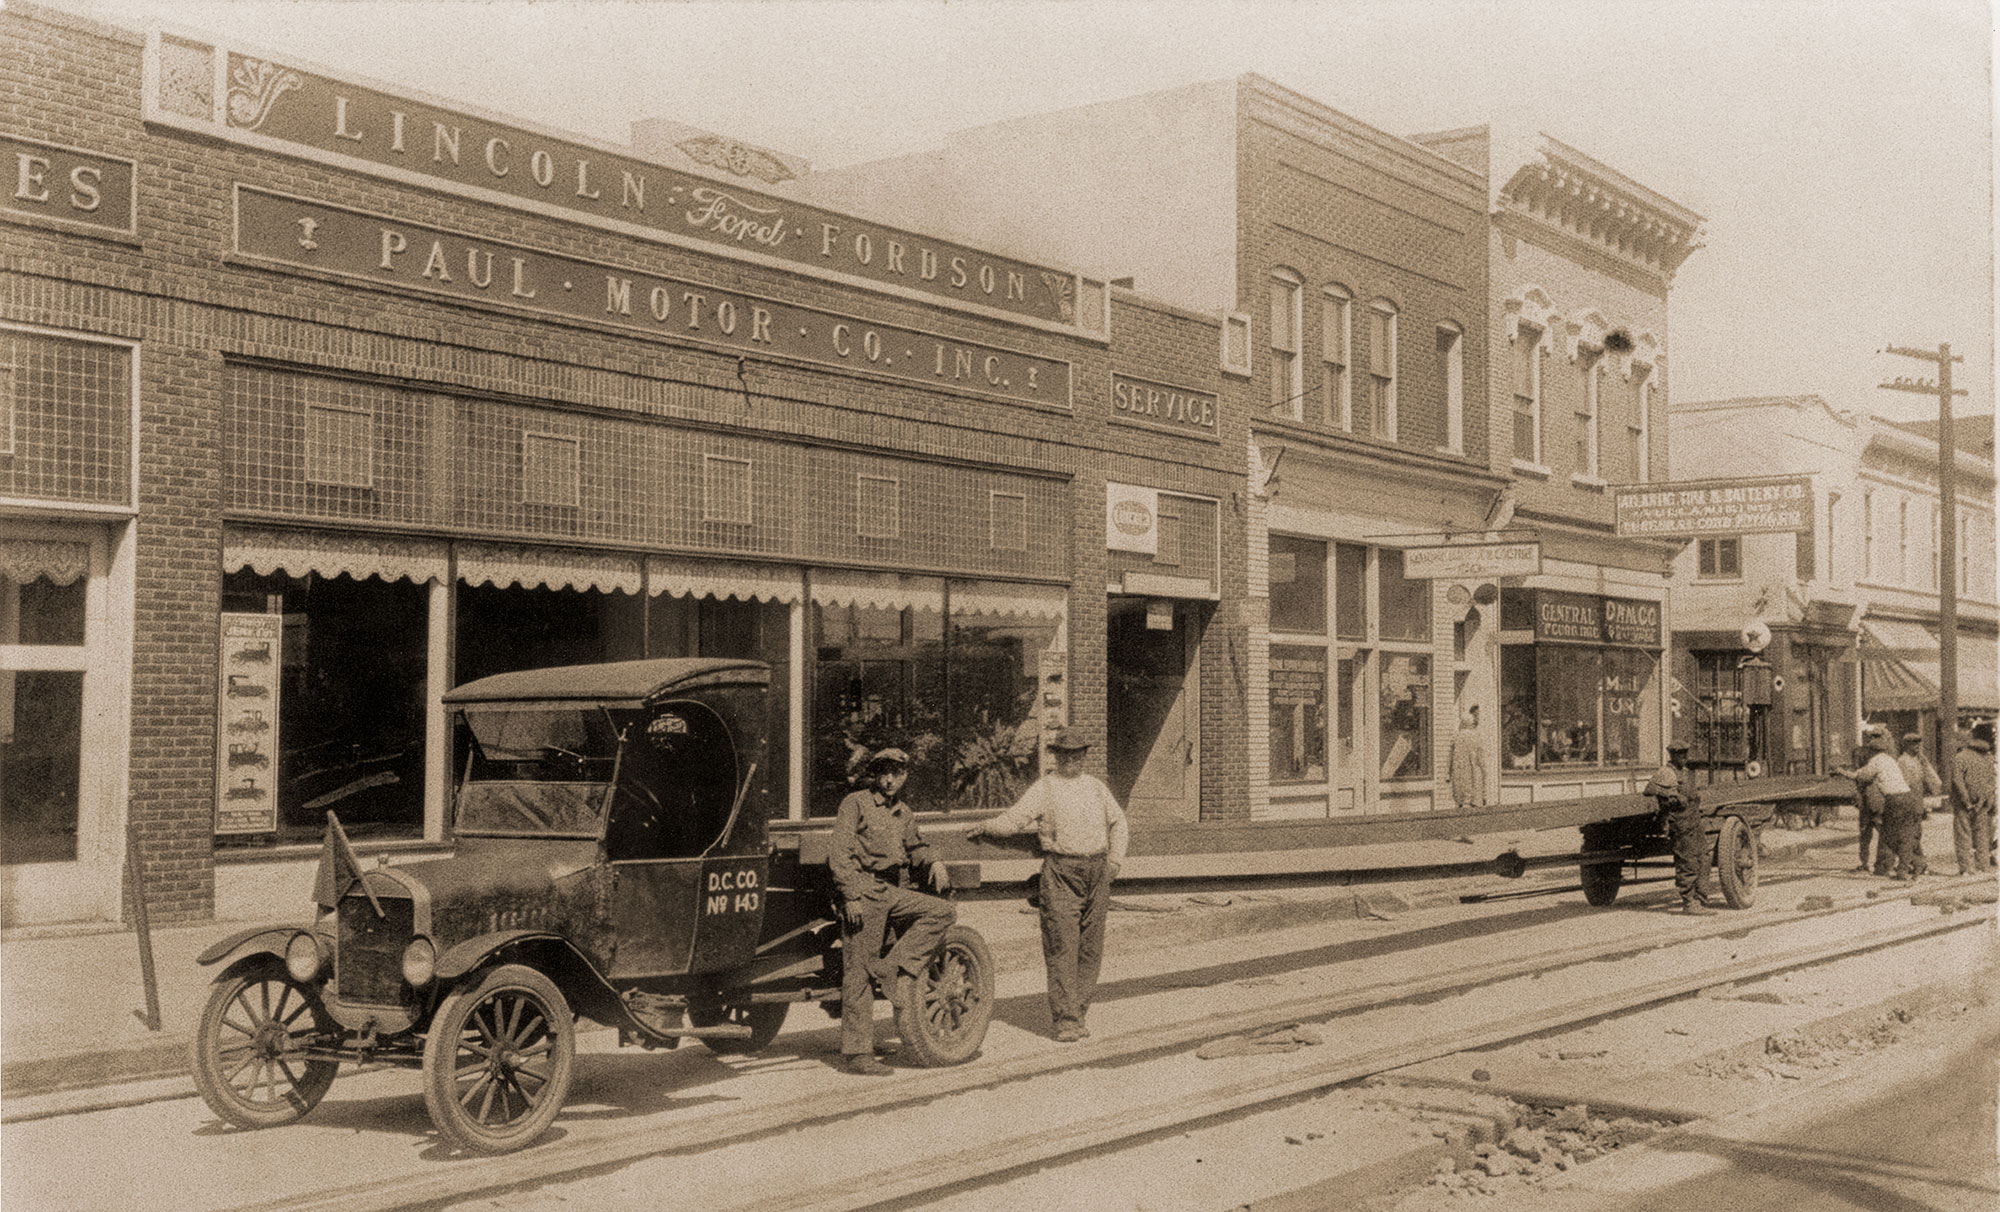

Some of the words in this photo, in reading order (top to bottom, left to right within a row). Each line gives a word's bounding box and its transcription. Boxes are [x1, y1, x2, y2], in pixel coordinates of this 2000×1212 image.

[14, 152, 102, 211] ES
[333, 97, 646, 209] LINCOLN
[685, 187, 787, 246] Ford
[821, 223, 1026, 301] FORDSON
[379, 228, 536, 299] PAUL
[606, 277, 773, 344] MOTOR
[832, 324, 893, 366] CO.
[935, 344, 1011, 388] INC.
[1115, 380, 1216, 429] SERVICE
[734, 892, 760, 913] 143
